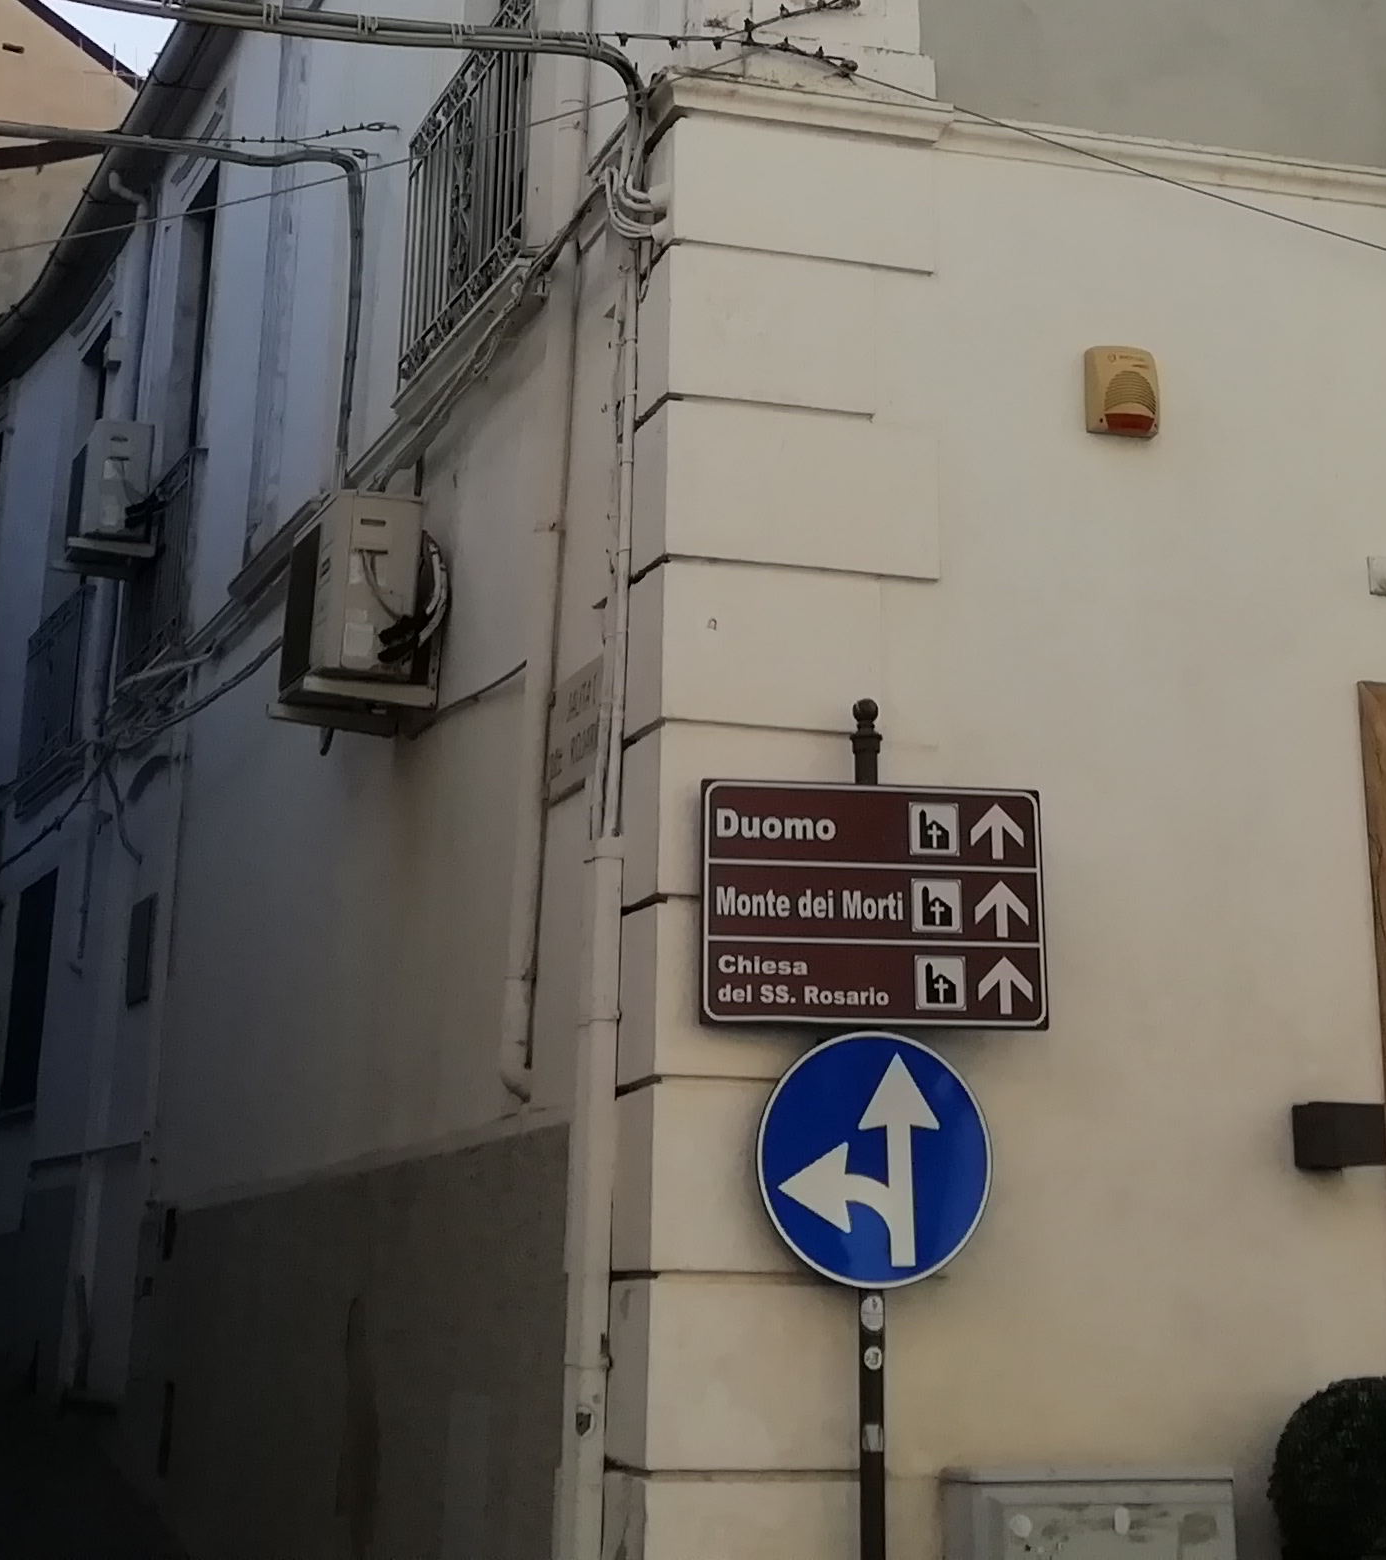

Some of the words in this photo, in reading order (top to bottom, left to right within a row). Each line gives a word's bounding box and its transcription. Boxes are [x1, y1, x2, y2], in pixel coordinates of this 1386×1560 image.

[716, 807, 837, 841] Duomo
[716, 886, 791, 918] Monte
[798, 888, 835, 919] dei
[842, 890, 905, 922] Morti
[718, 954, 809, 976] Chiesa
[717, 983, 753, 1004] del
[760, 984, 797, 1005] SS.
[803, 986, 890, 1007] Rosario
